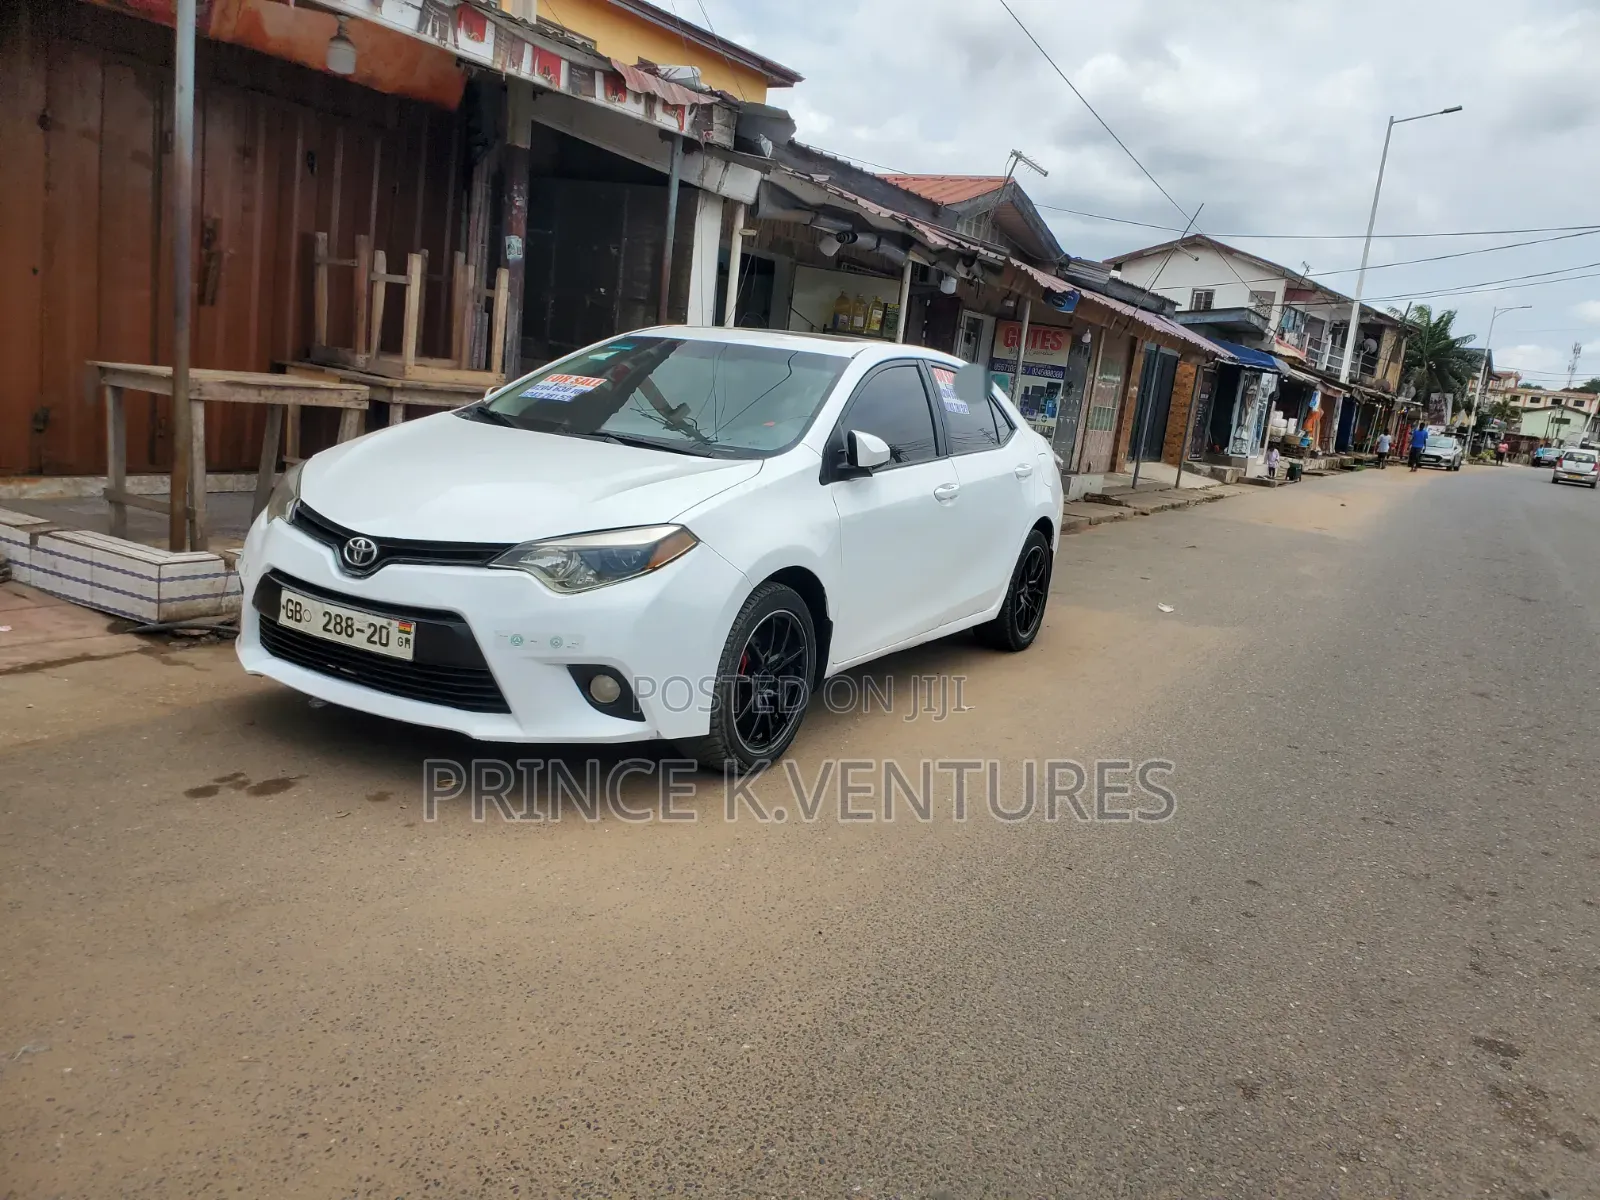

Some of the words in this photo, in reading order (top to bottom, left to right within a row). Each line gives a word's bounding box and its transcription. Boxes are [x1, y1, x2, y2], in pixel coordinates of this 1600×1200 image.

[544, 375, 573, 384] FOR
[570, 376, 606, 387] SALE
[322, 610, 391, 648] 288-20
